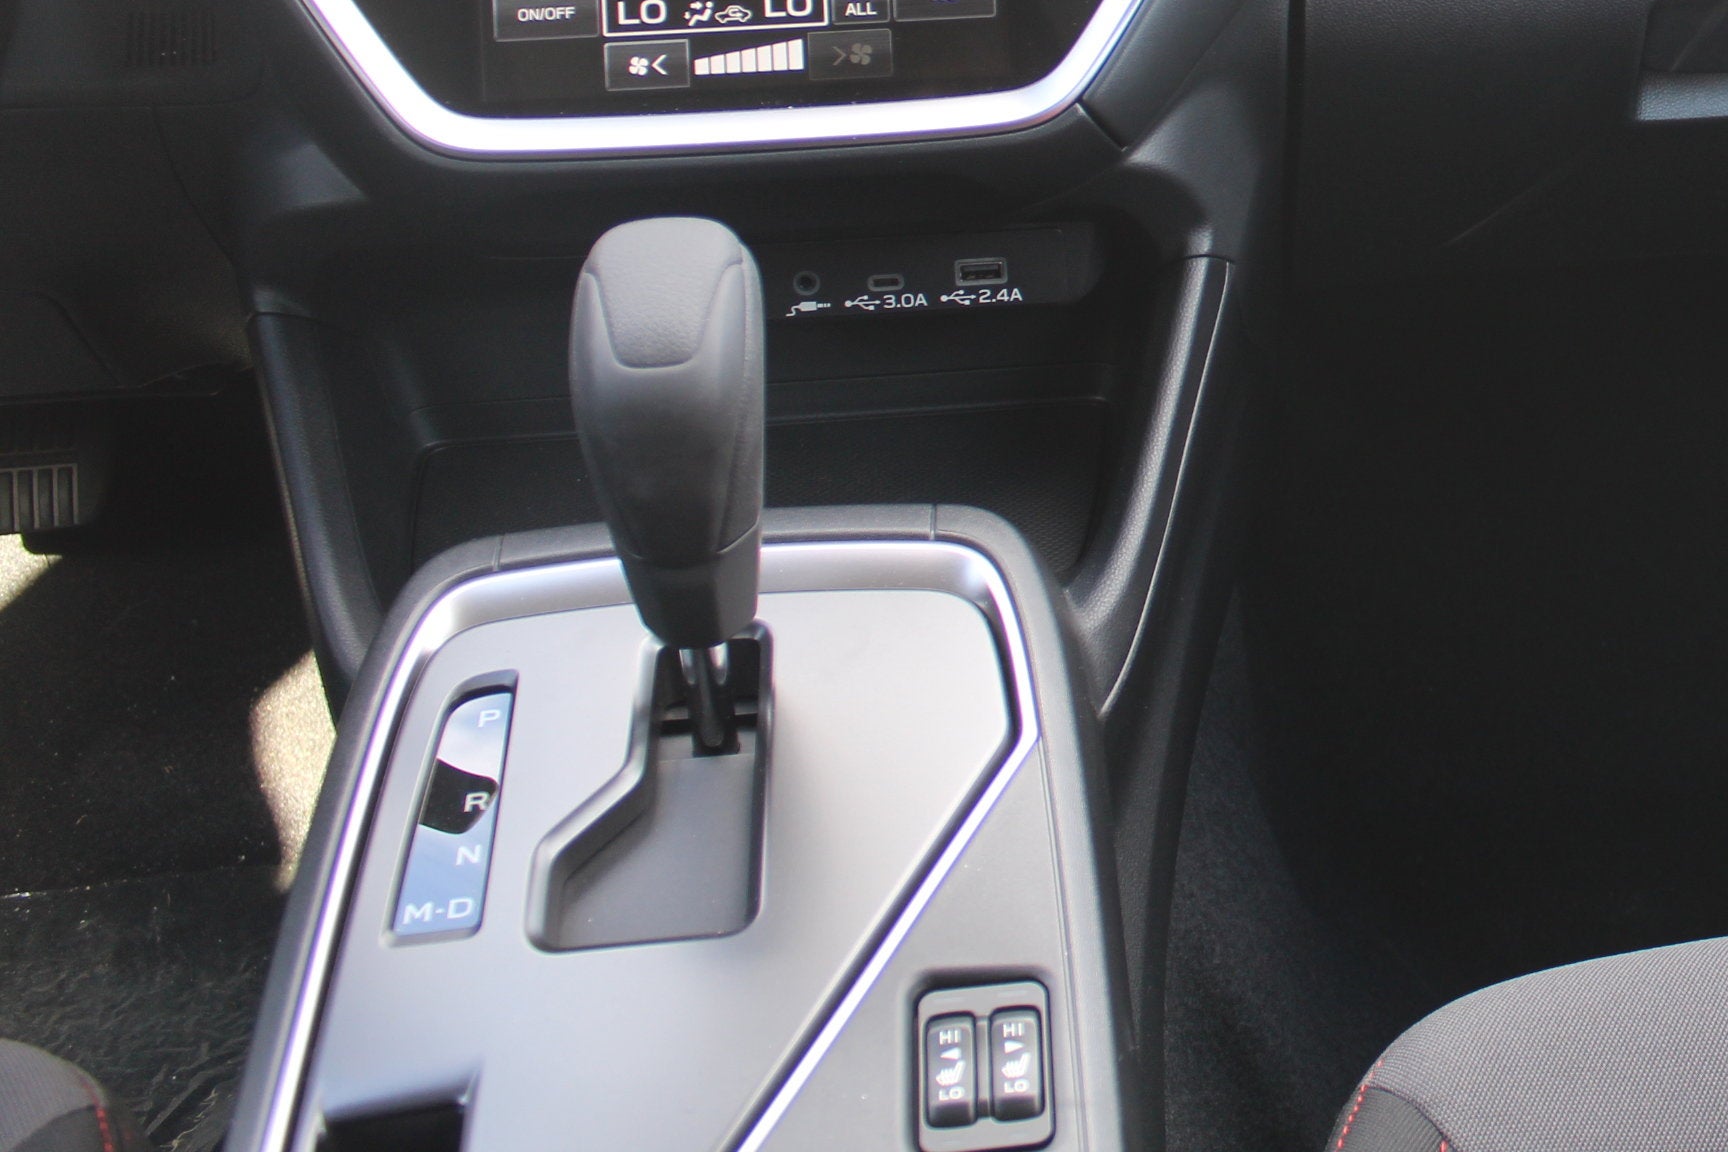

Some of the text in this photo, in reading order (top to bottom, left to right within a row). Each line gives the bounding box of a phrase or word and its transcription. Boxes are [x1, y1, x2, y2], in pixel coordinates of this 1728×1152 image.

[517, 6, 577, 22] ON/OFF
[844, 2, 878, 17] ALL
[883, 293, 928, 309] 3.0A
[977, 287, 1023, 304] 2.4A
[477, 708, 501, 728] P
[463, 790, 491, 813] R
[455, 844, 482, 866] N
[402, 898, 475, 926] M-D
[939, 1029, 962, 1045] HI
[1002, 1022, 1025, 1038] HI
[938, 1085, 966, 1101] LO
[1003, 1078, 1031, 1094] LO
